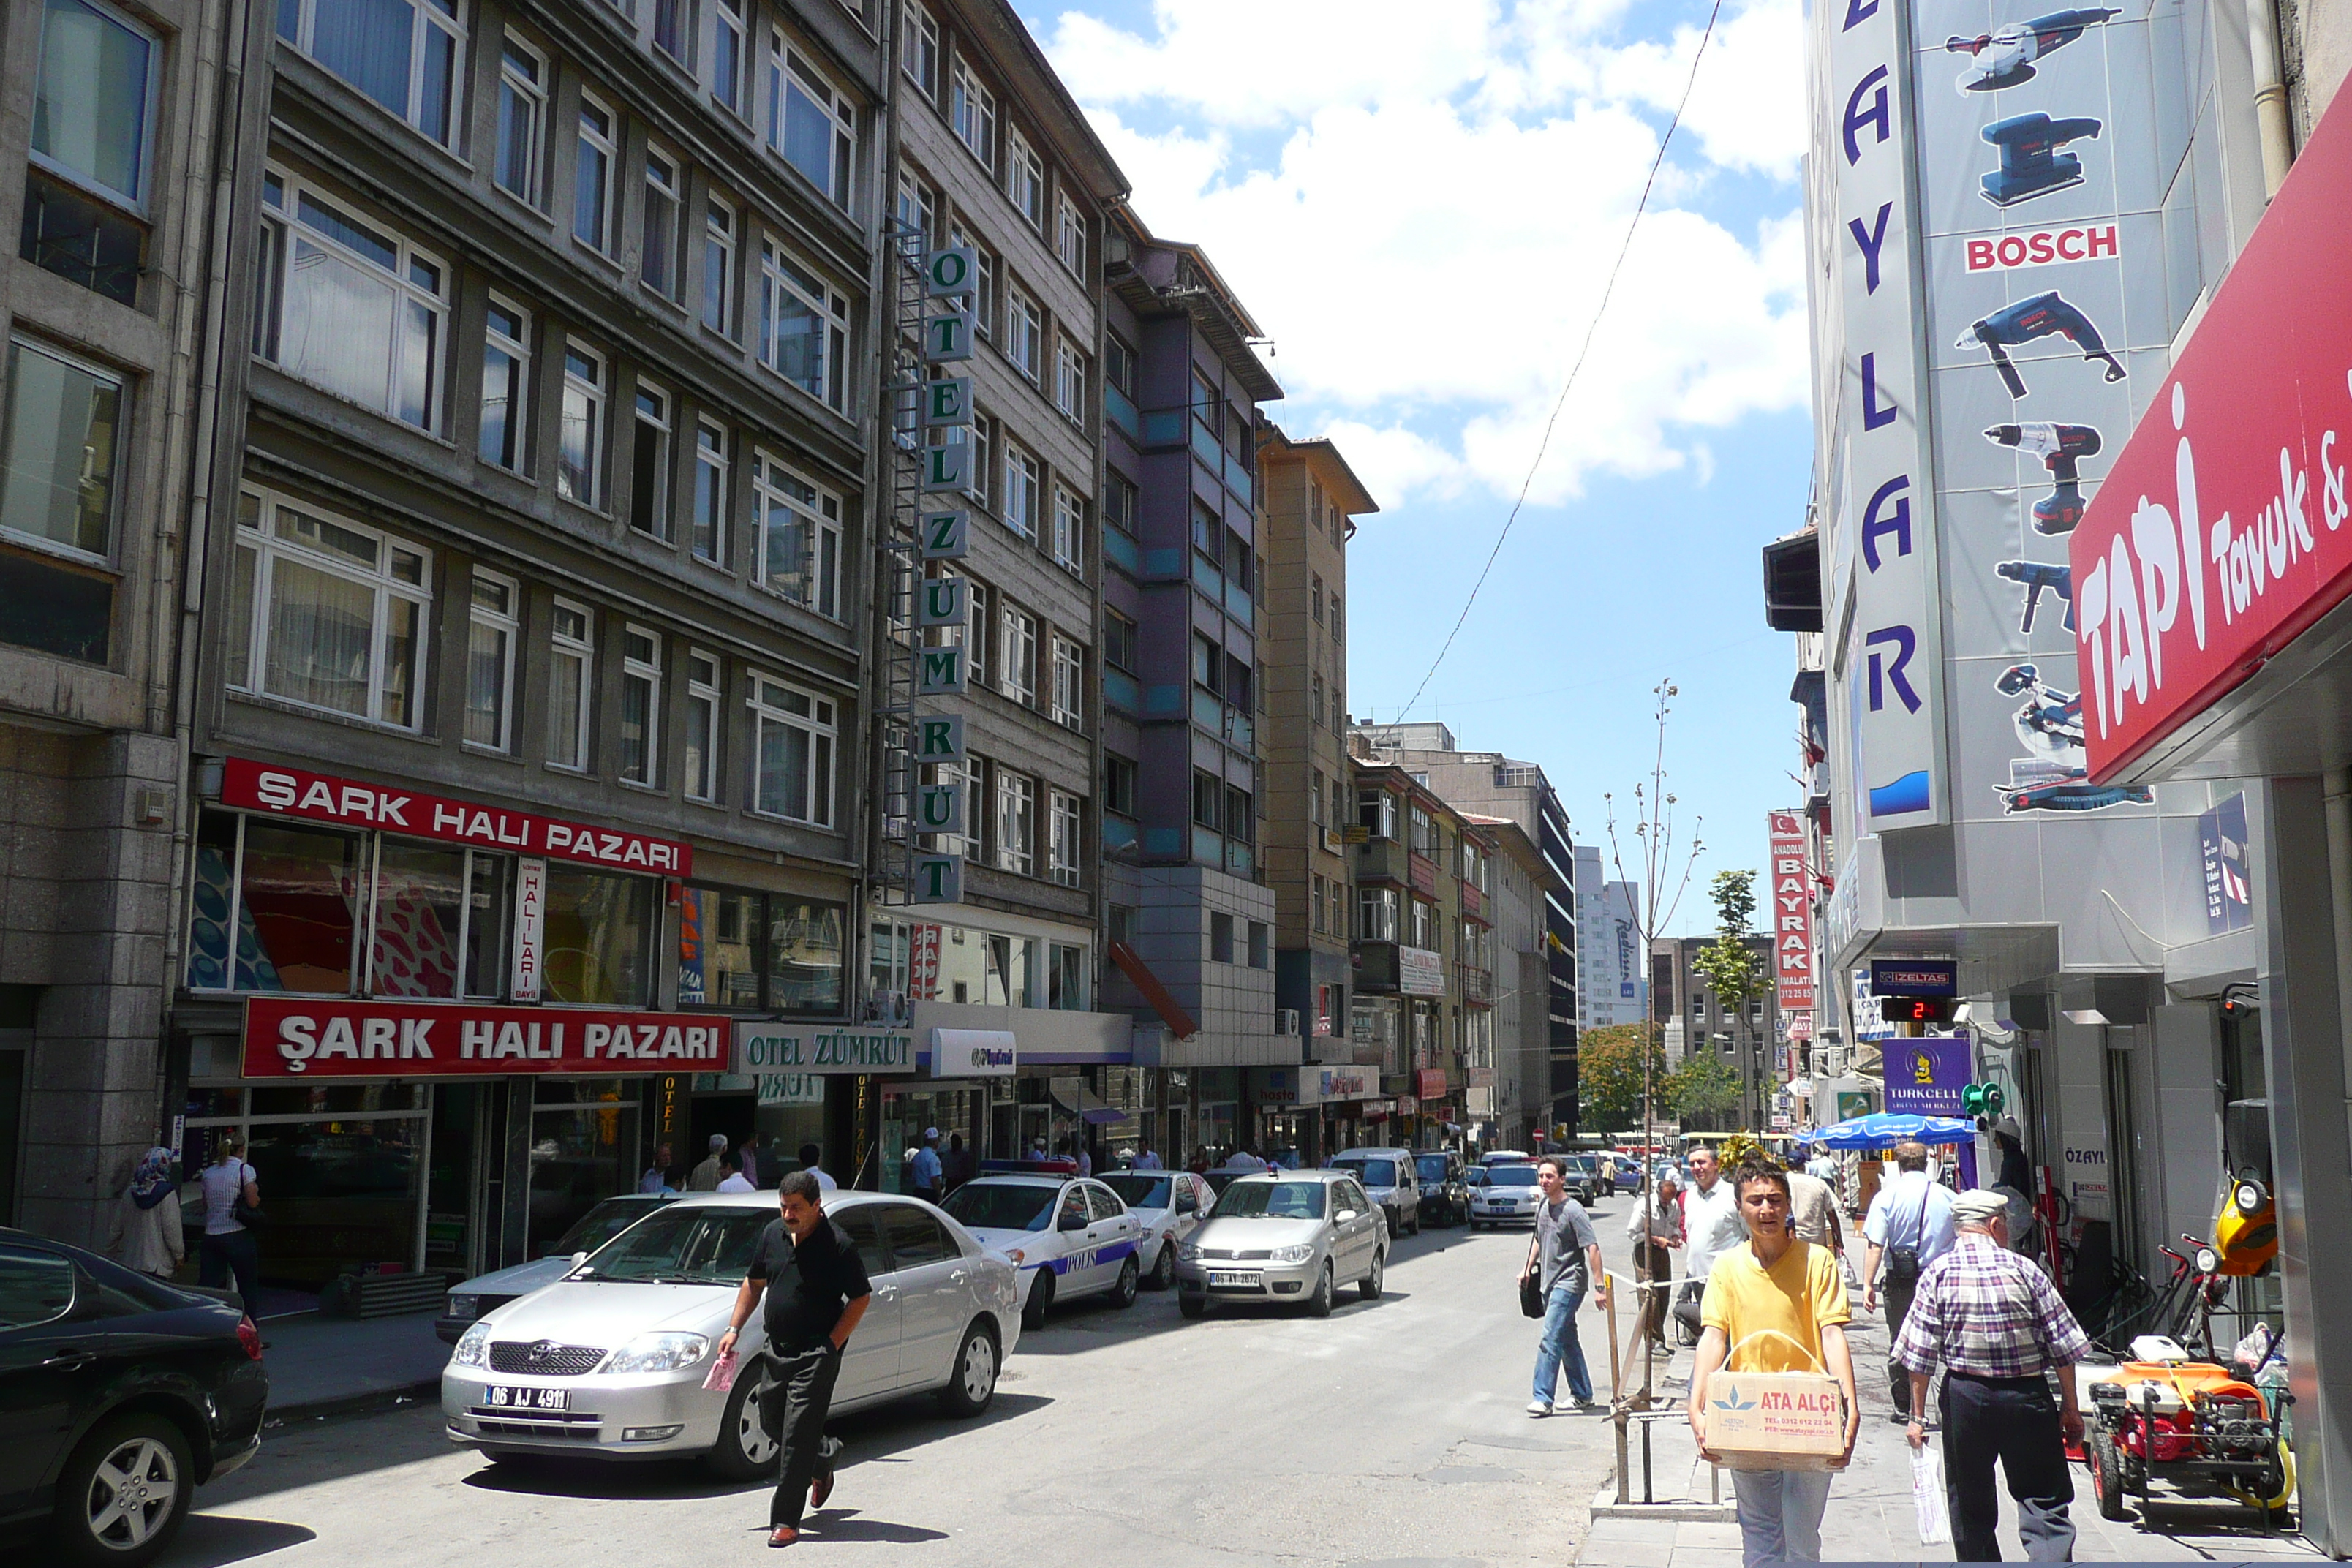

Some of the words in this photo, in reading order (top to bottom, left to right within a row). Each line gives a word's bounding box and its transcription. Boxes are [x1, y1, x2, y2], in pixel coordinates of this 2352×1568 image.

[1967, 225, 2118, 271] BOSCH
[931, 253, 967, 485] OTEL
[2211, 447, 2314, 626] Tavuk
[2321, 429, 2348, 532] &
[920, 515, 958, 898] ZÜMRÜT
[258, 771, 412, 827] ŞARK
[434, 803, 529, 847] HALI
[546, 824, 679, 871] PAZARI
[1774, 843, 1803, 855] ANADOLU
[521, 876, 538, 987] HALILARI
[1778, 859, 1808, 970] BAYRAK
[1794, 989, 1802, 998] 25
[277, 1014, 437, 1073] ŞARK
[460, 1020, 564, 1059] HALI
[585, 1024, 720, 1060] PAZARI
[747, 1036, 804, 1066] OTEL
[813, 1028, 912, 1066] ZÜMRÜT
[663, 1077, 675, 1133] OTEL
[1215, 1273, 1224, 1283] 06
[492, 1387, 508, 1405] 06
[513, 1388, 532, 1406] AJ
[538, 1389, 565, 1409] 4911
[1760, 1392, 1792, 1411] ATA
